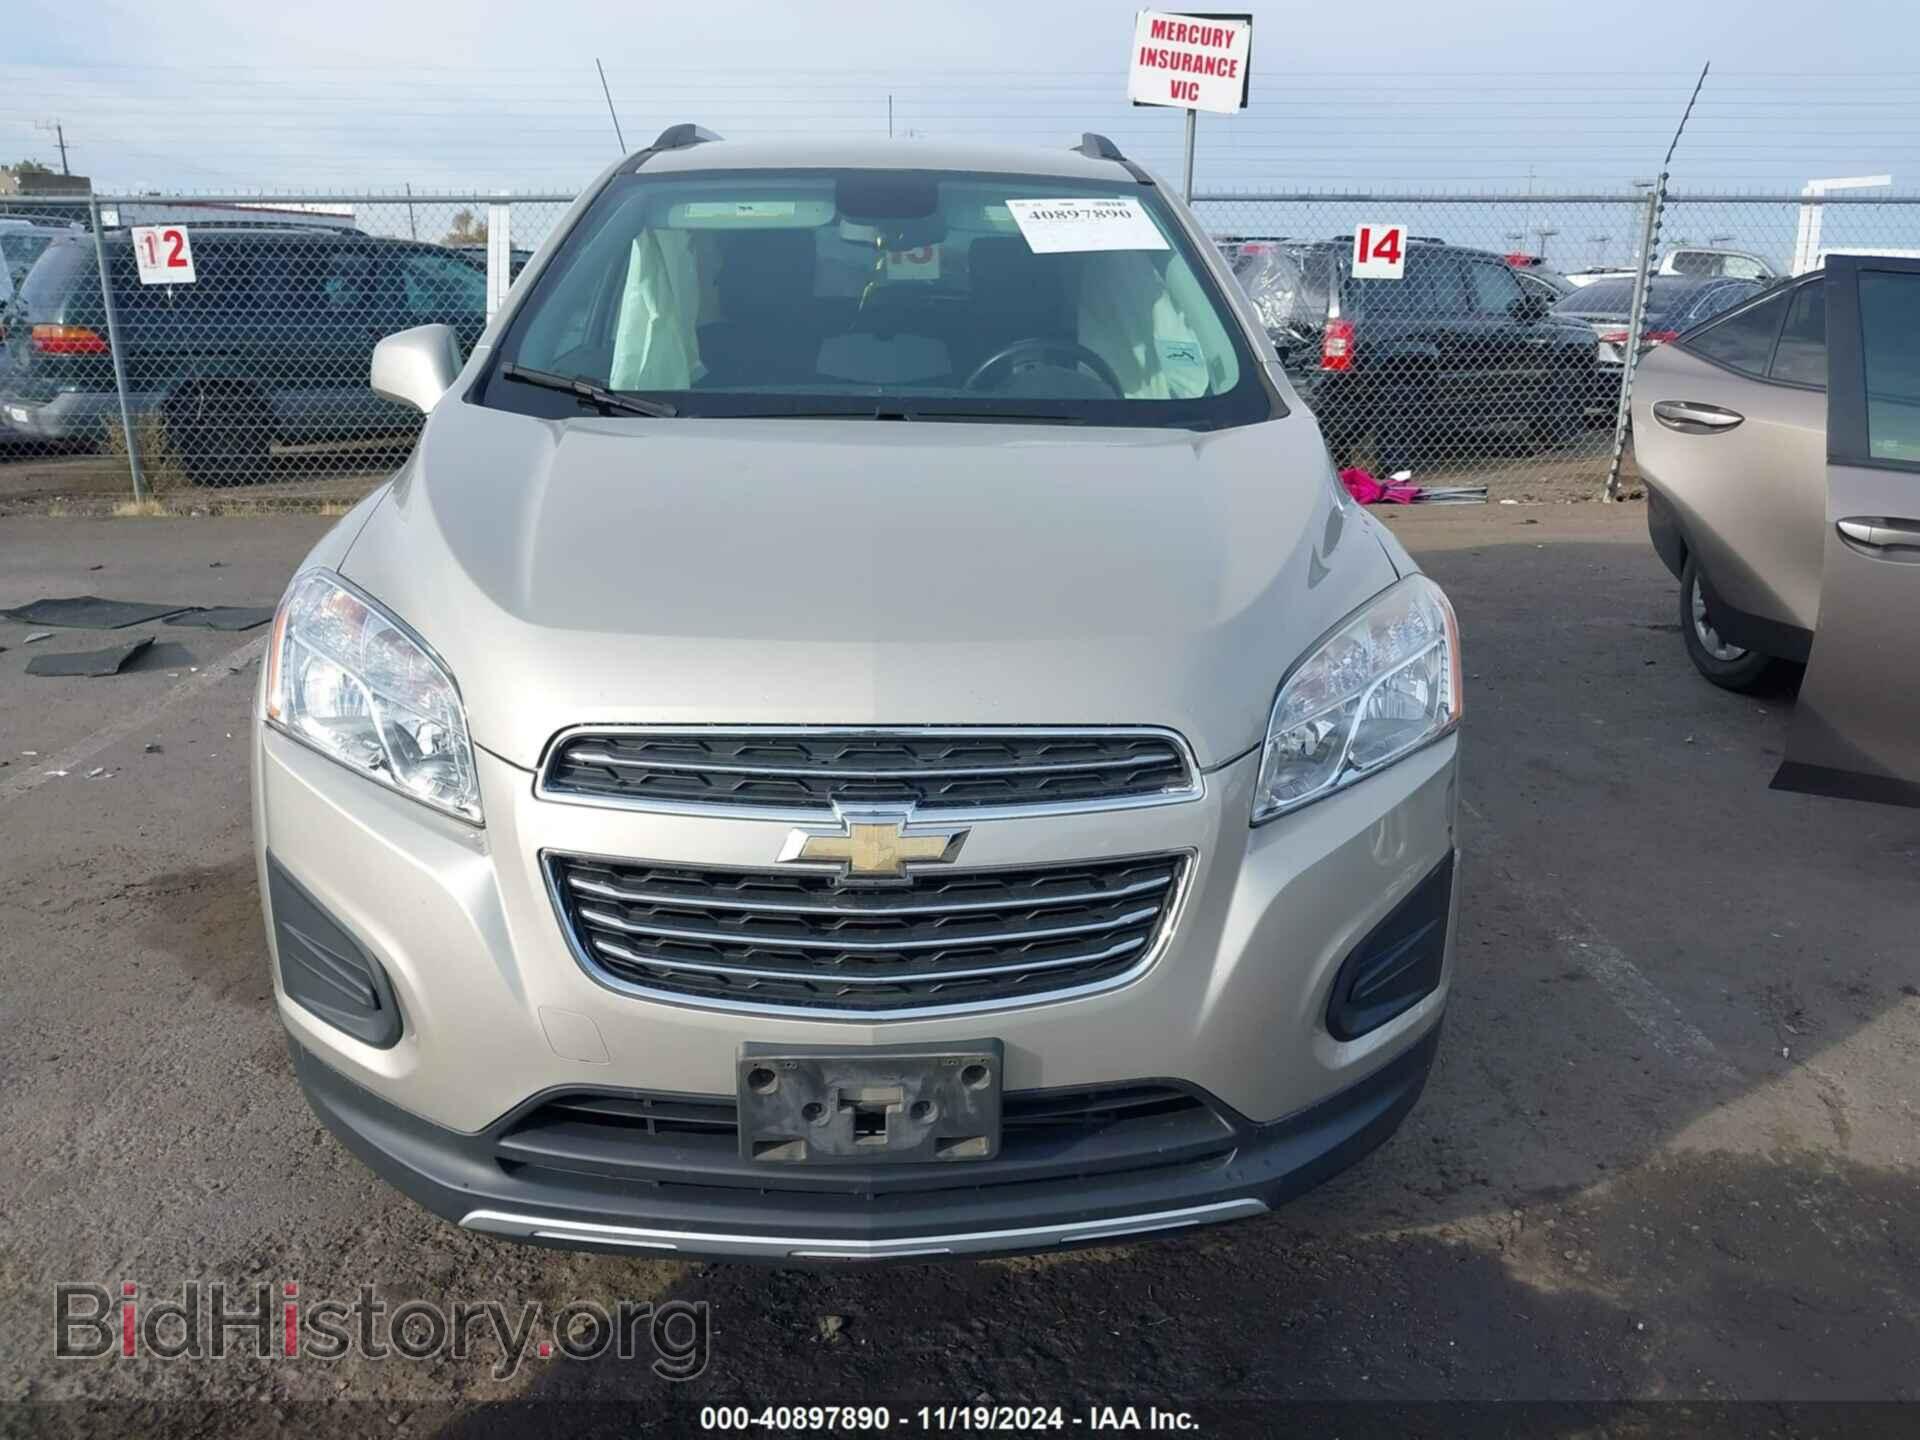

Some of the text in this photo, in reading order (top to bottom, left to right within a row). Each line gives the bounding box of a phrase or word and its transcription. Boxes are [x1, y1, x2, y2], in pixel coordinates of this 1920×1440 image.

[1150, 19, 1235, 49] MERCURY
[1139, 47, 1238, 78] INSURANCE
[1170, 80, 1200, 101] VIC
[1028, 208, 1133, 221] 40897890
[145, 230, 188, 267] 12
[1358, 228, 1402, 264] 14
